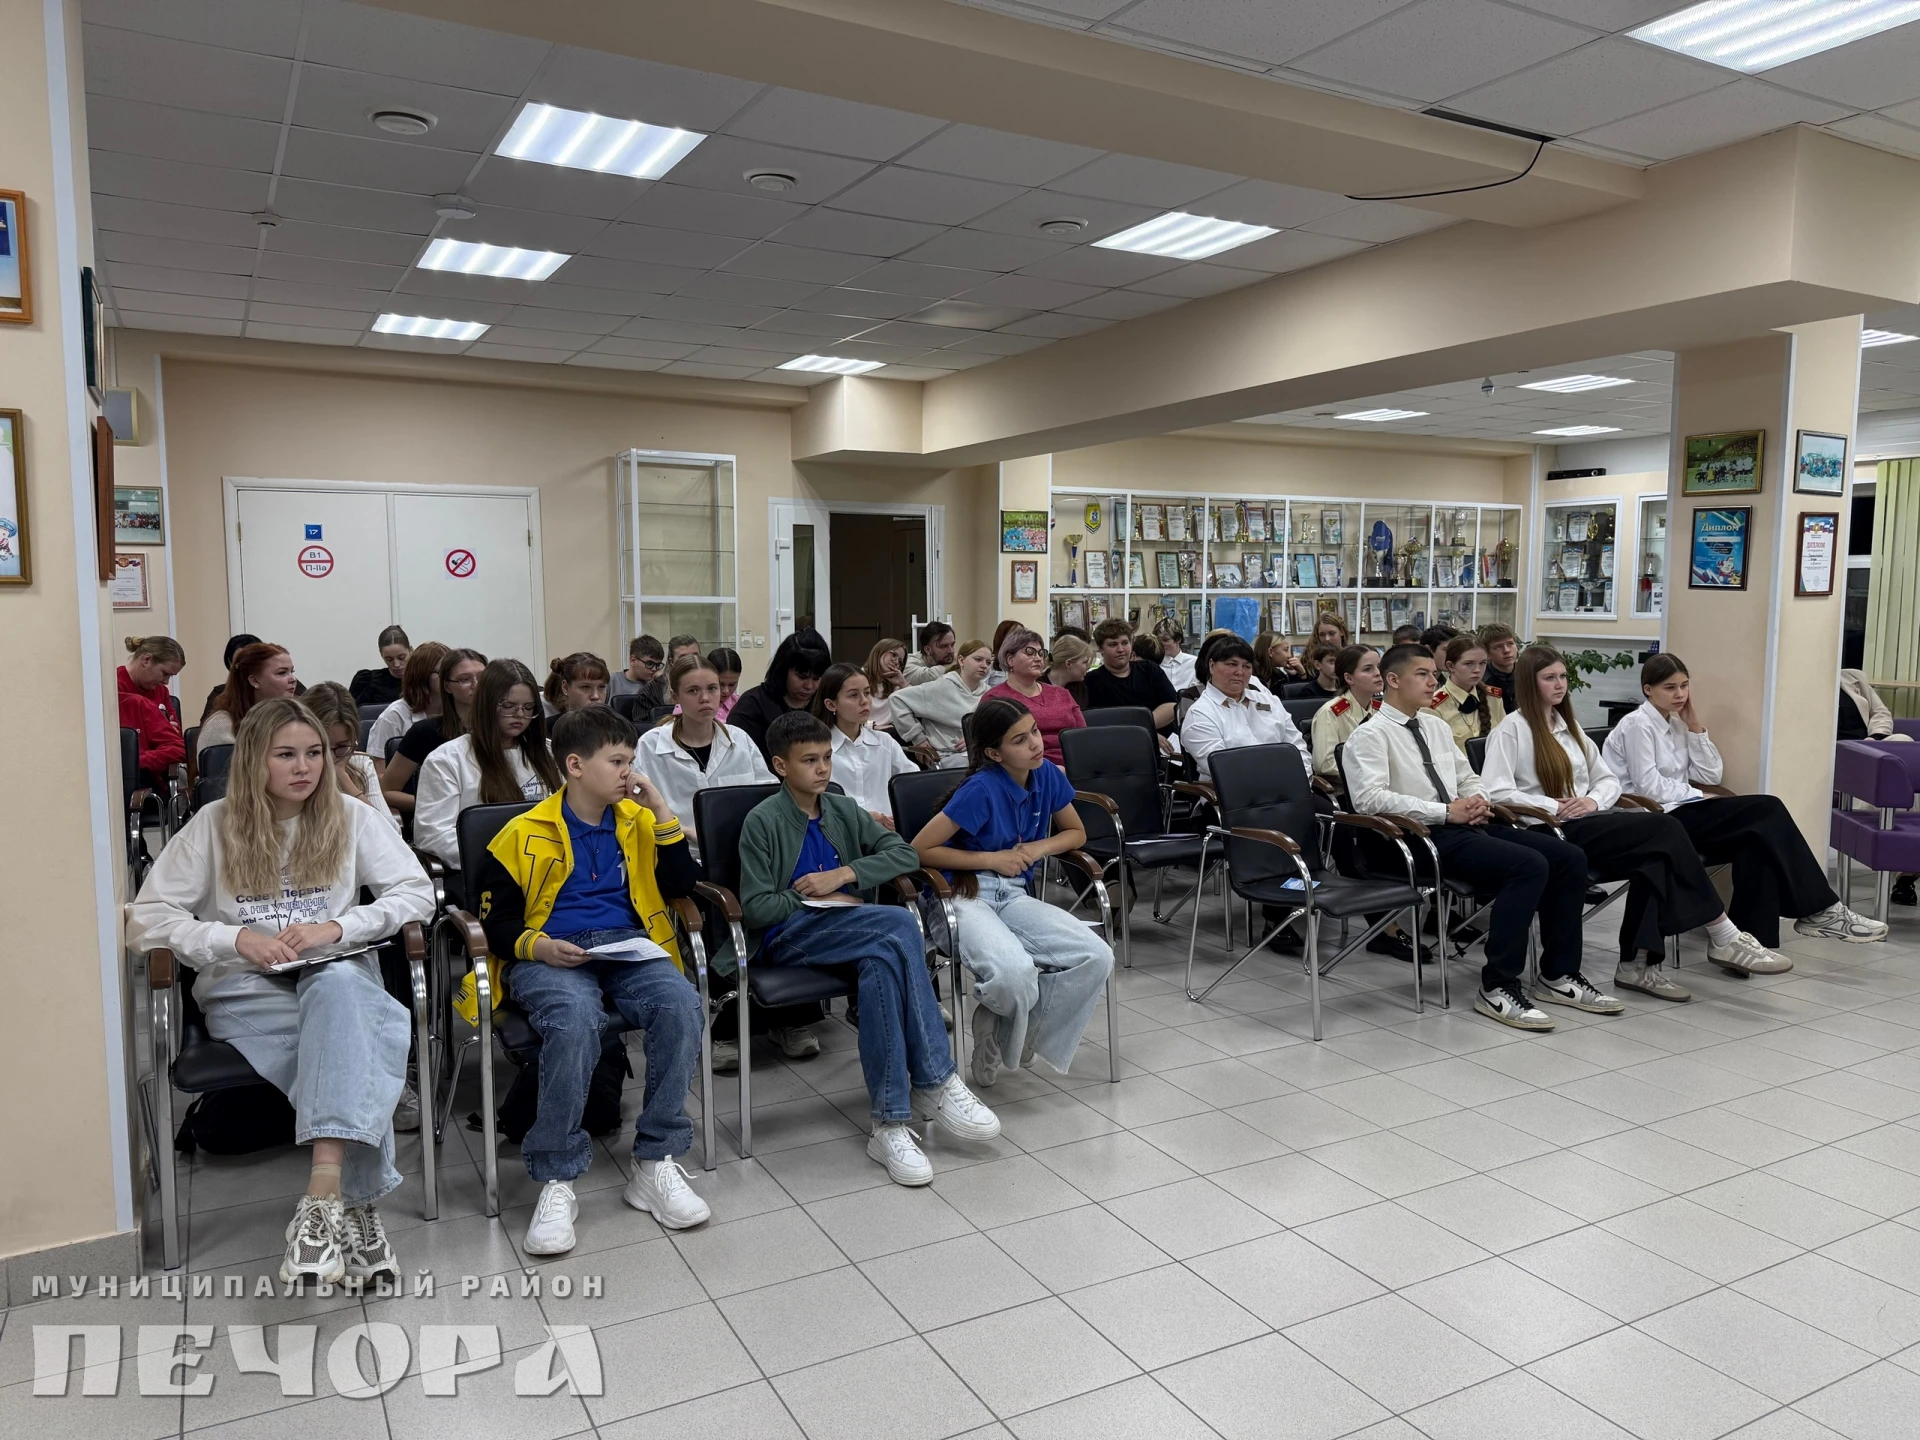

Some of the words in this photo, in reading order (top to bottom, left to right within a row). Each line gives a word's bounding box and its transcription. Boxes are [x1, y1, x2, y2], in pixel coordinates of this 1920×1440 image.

[1701, 523, 1740, 532] Диплом
[309, 551, 321, 559] В1
[281, 885, 332, 898] Первых
[251, 904, 270, 915] НЕ
[242, 917, 257, 925] МЫ
